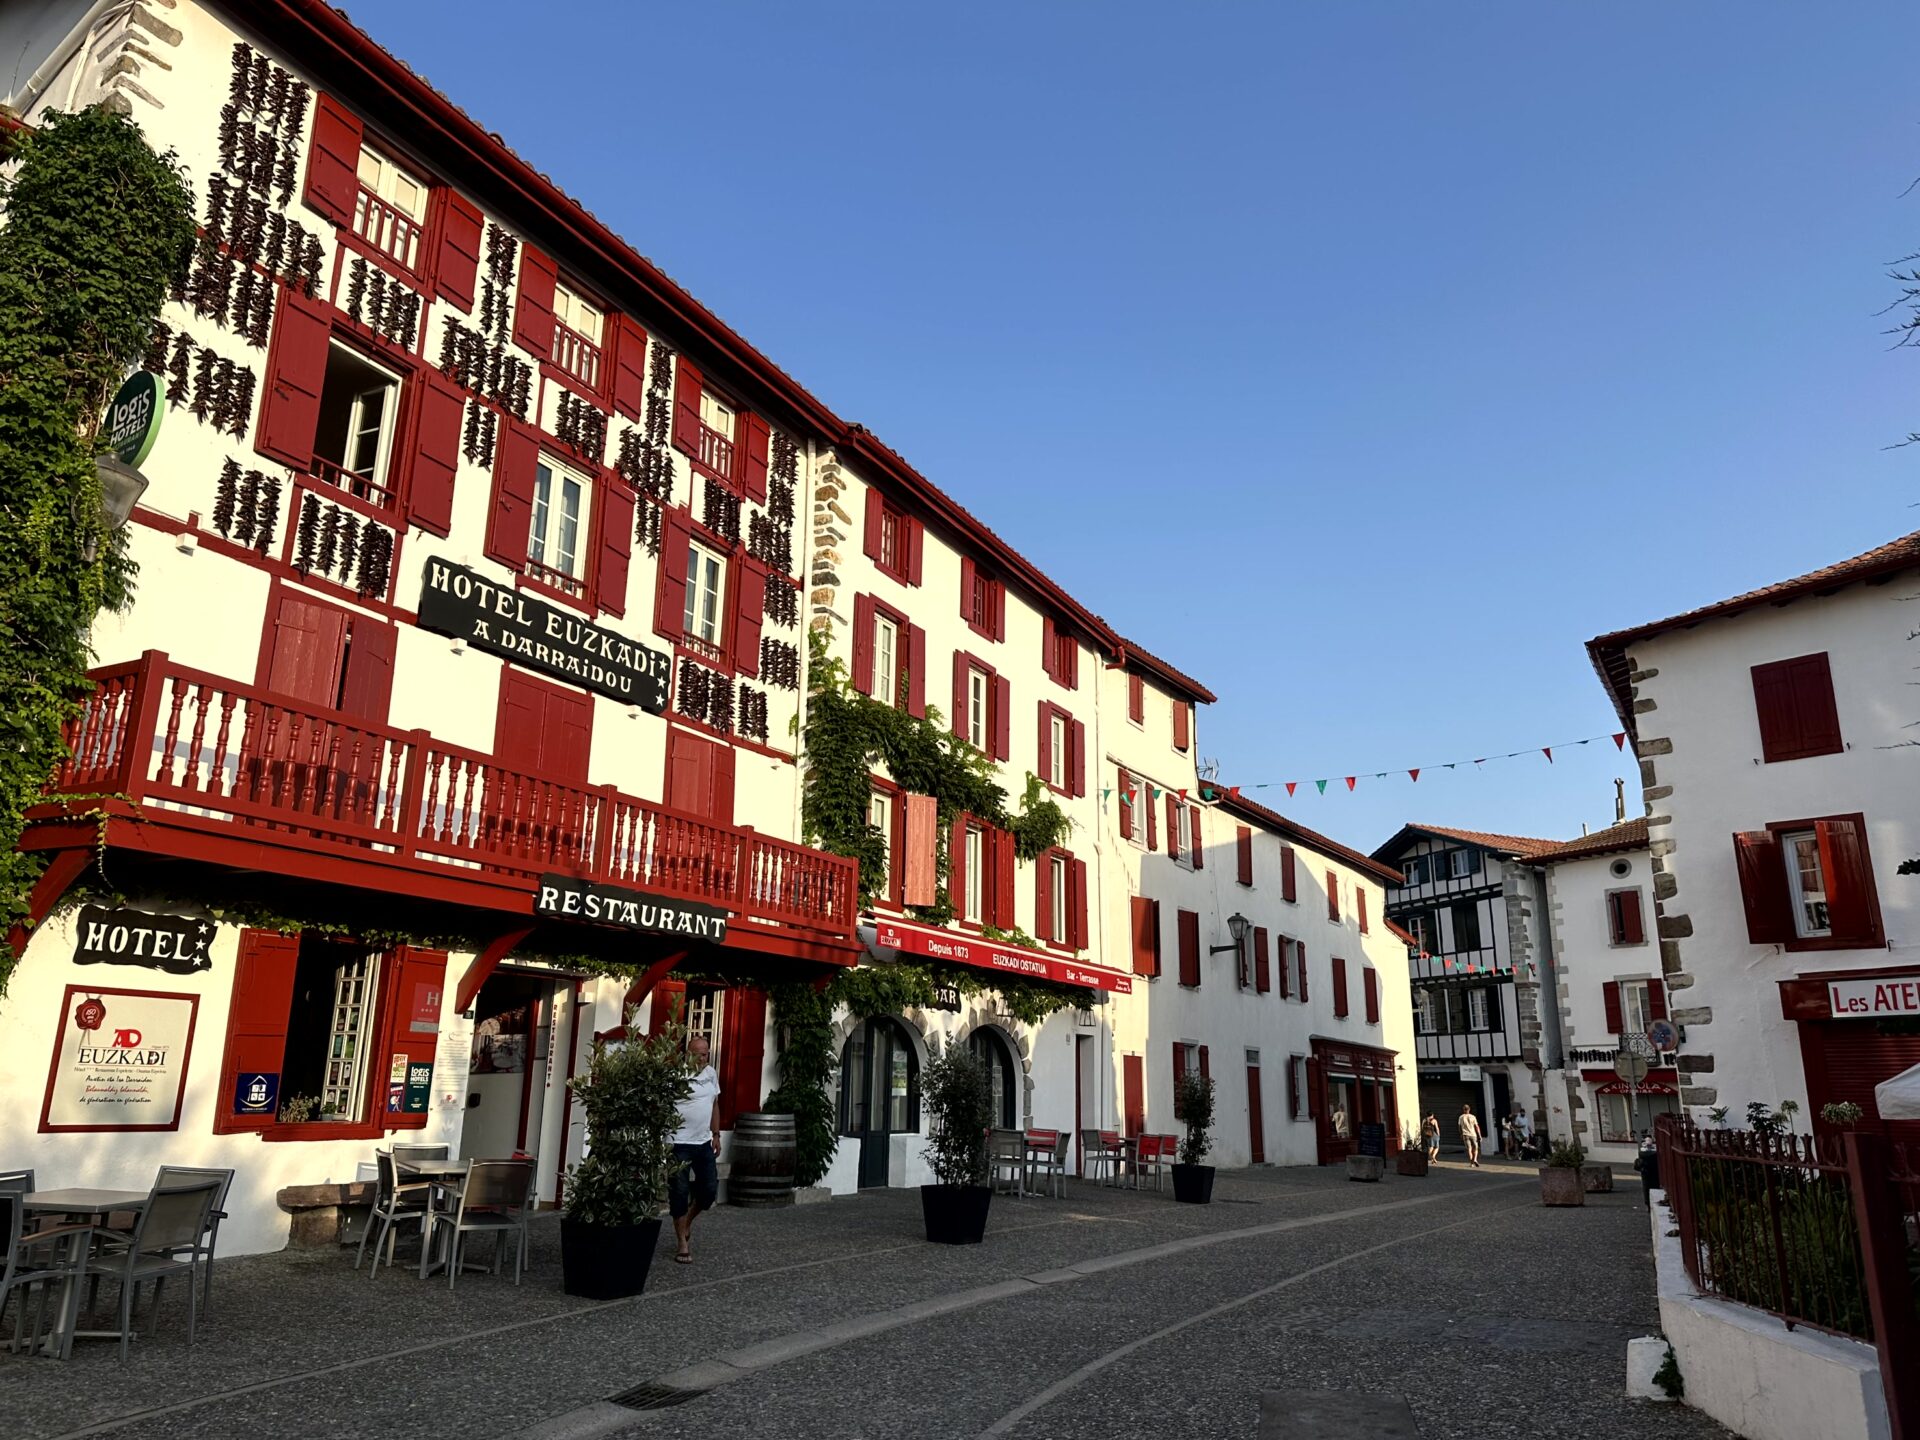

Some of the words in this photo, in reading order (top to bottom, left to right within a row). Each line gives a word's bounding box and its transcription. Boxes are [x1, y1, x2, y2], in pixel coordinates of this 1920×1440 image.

[109, 413, 148, 447] HOTELS
[430, 562, 533, 627] HOTEL
[538, 886, 726, 938] RESTAURANT
[83, 921, 194, 961] HOTEL
[928, 939, 952, 956] Depuis
[953, 945, 969, 959] 1873
[992, 953, 1020, 969] EUZKADI
[1020, 959, 1047, 975] OSTATUA
[1066, 969, 1076, 981] Bar
[1079, 971, 1100, 985] Terrasse
[426, 991, 440, 1007] H
[1832, 987, 1869, 1013] Les
[546, 1004, 558, 1080] RESTAURANT
[78, 1048, 168, 1066] EUZKADI
